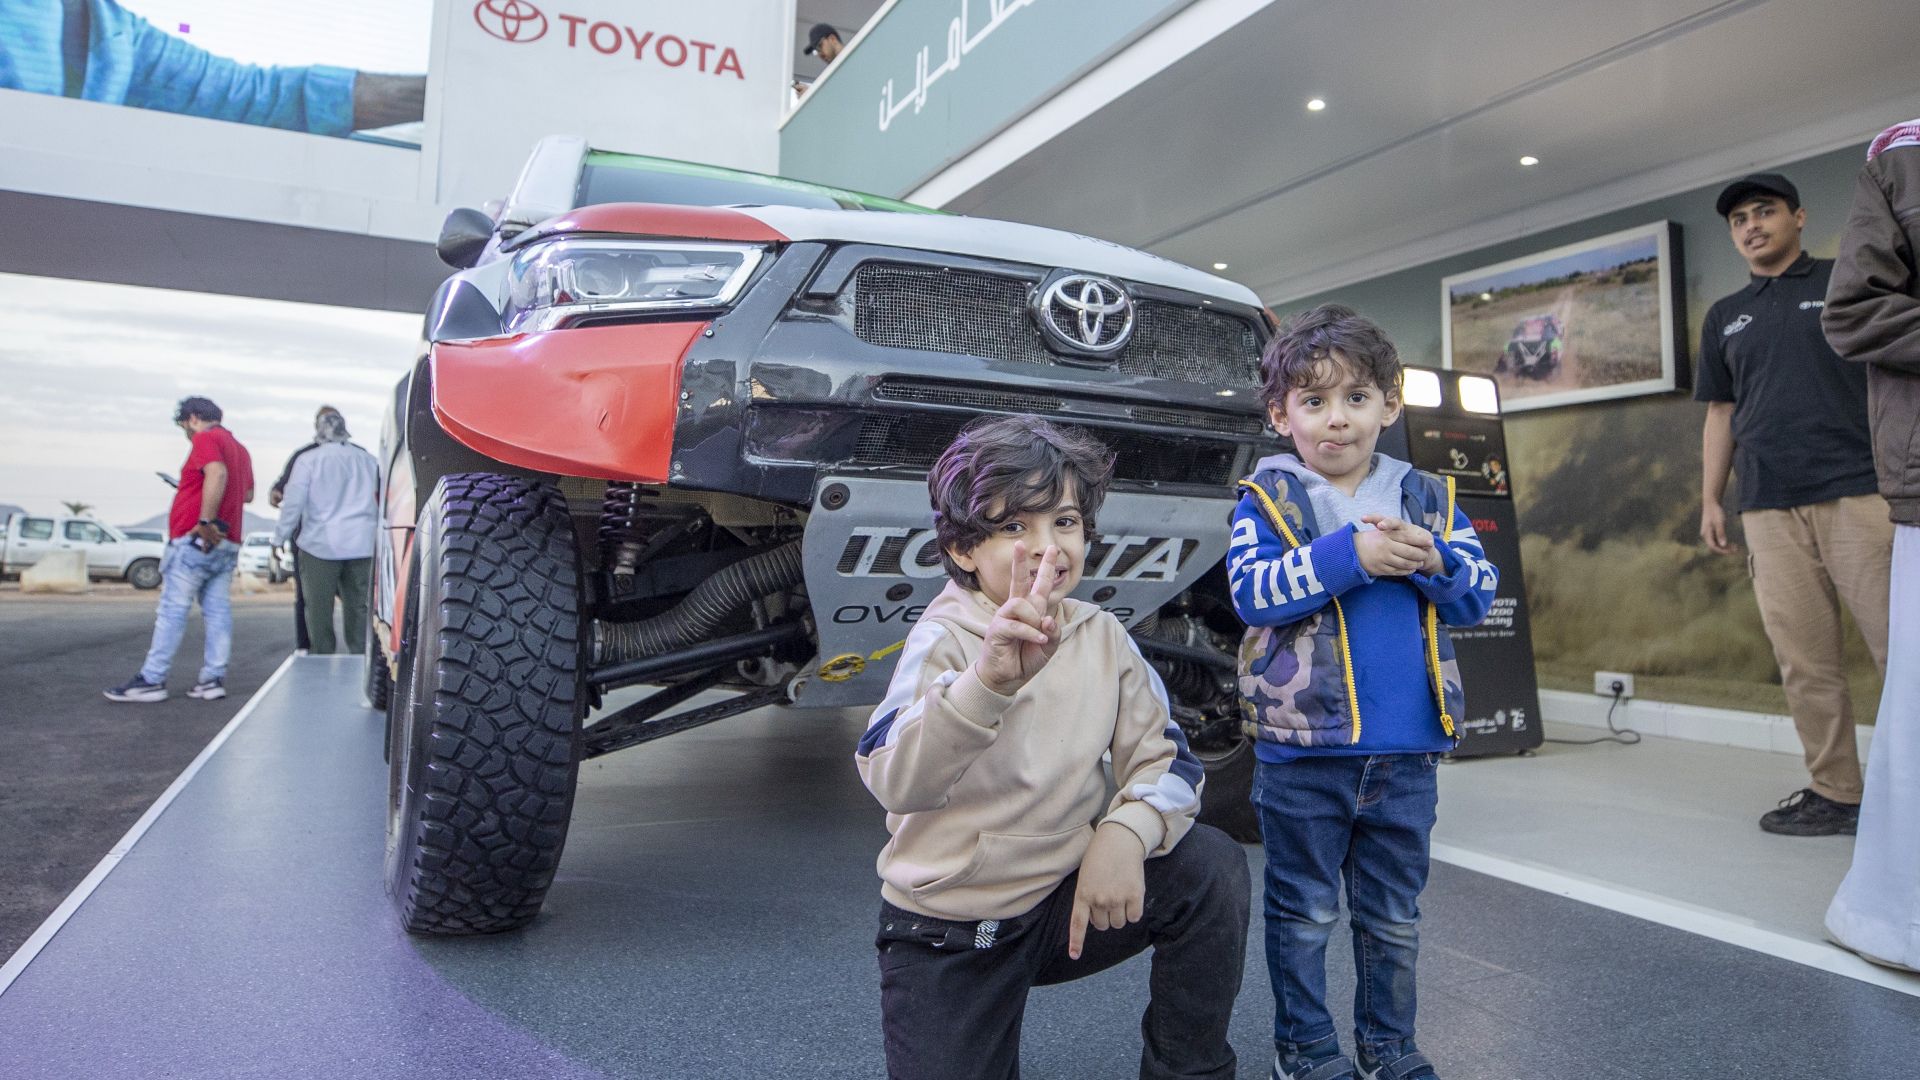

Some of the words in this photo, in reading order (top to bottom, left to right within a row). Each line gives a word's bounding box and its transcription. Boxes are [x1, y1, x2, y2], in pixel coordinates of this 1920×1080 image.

[558, 13, 745, 80] TOYOTA
[849, 526, 1184, 582] TOTA
[1483, 616, 1513, 628] acing
[1487, 607, 1514, 617] AZOO
